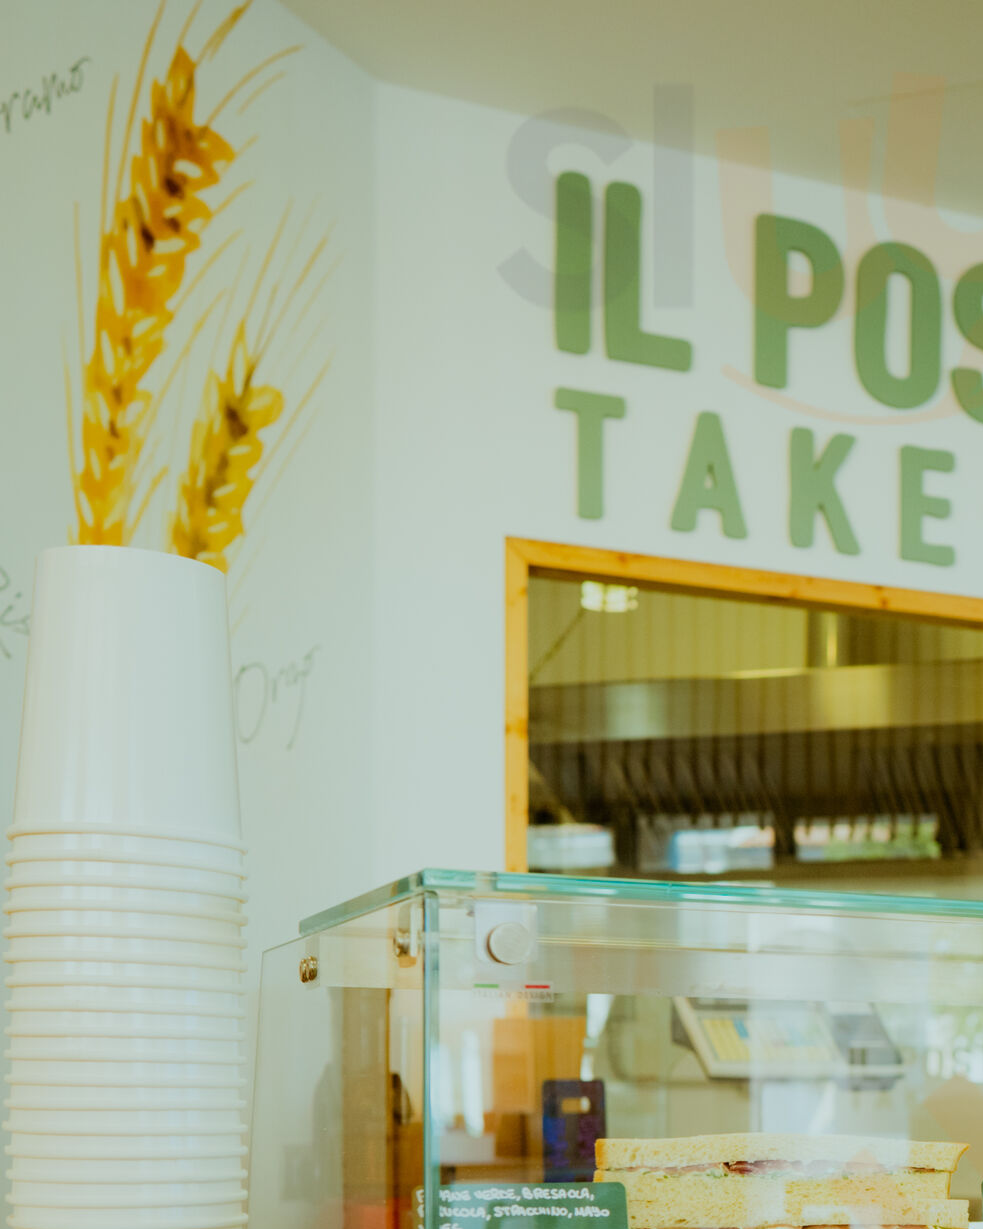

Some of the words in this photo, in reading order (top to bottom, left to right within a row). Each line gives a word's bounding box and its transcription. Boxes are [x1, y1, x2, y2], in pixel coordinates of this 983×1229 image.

[554, 169, 692, 372] IL
[474, 1188, 520, 1202] VERDE,
[521, 1186, 596, 1202] BRESAOLA,
[494, 1203, 573, 1220] STRACCHINO,
[575, 1206, 611, 1218] MAYO
